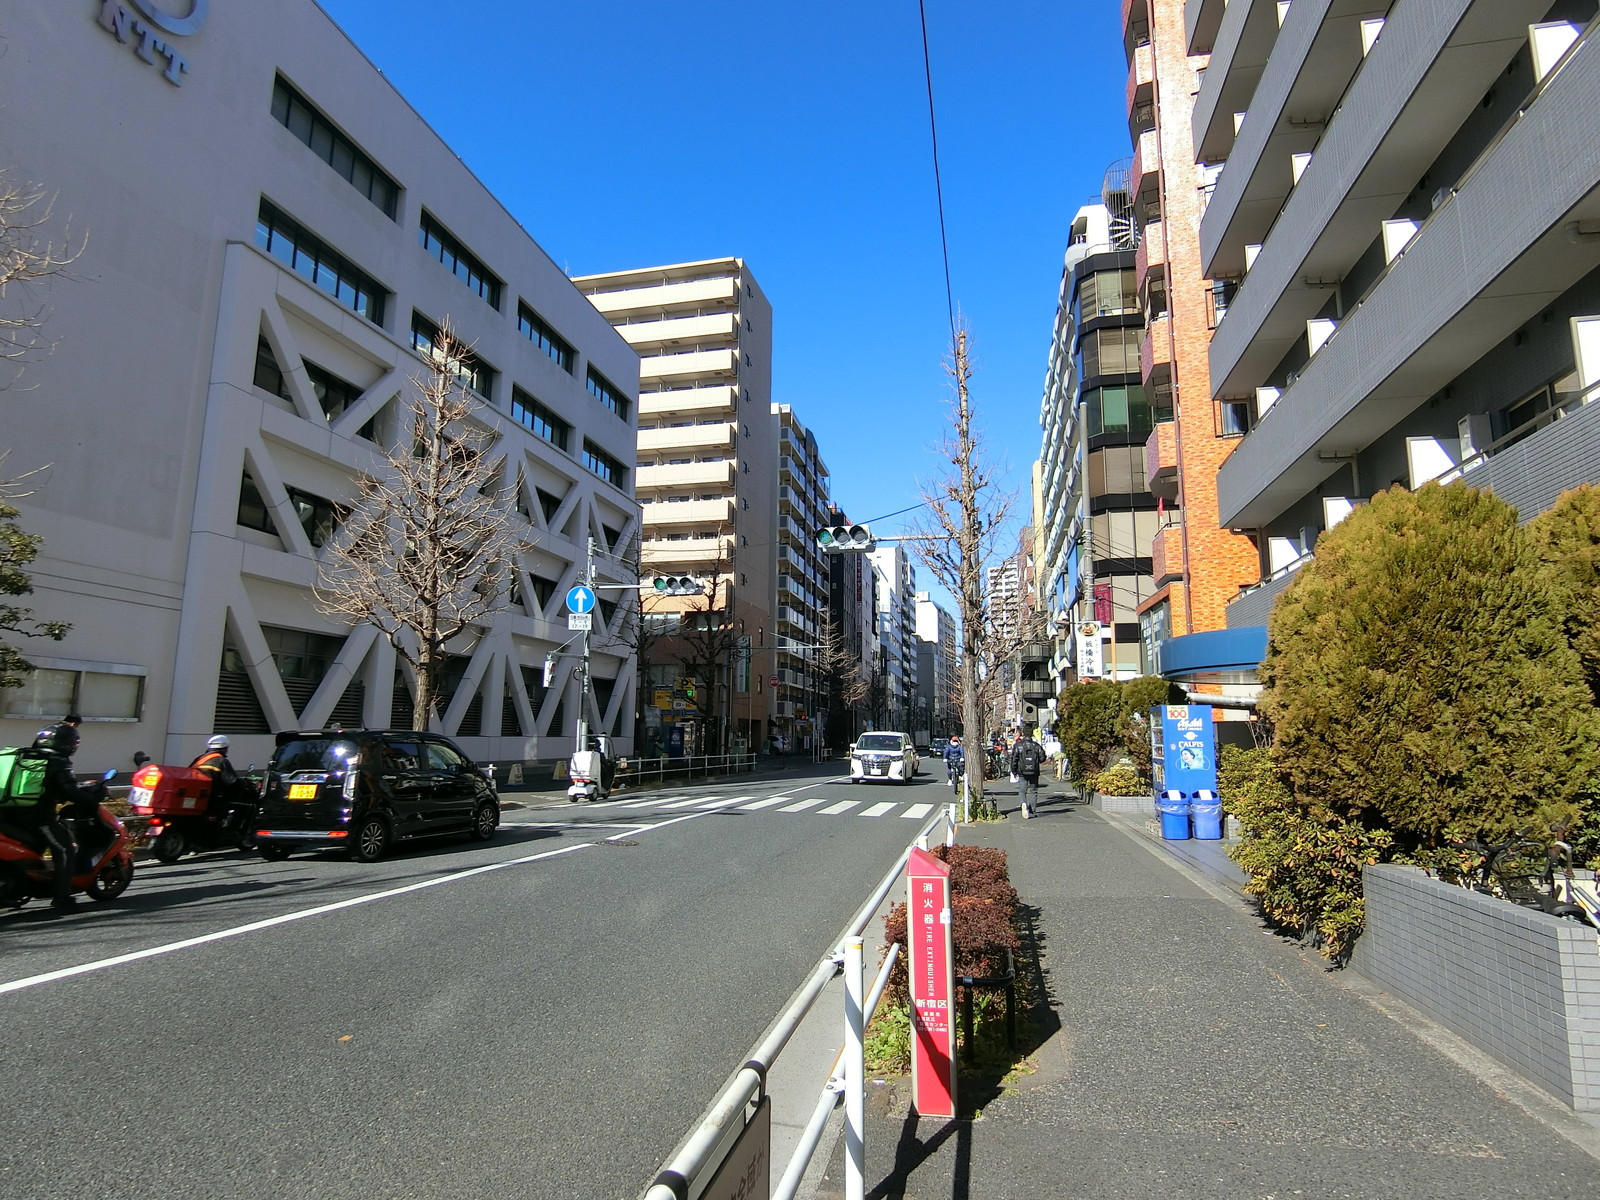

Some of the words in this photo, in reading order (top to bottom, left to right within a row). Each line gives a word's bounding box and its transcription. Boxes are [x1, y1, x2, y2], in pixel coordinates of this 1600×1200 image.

[96, 0, 189, 87] NTT
[1169, 709, 1186, 718] 100
[923, 882, 933, 924] 消火器
[916, 998, 947, 1008] 新宿区
